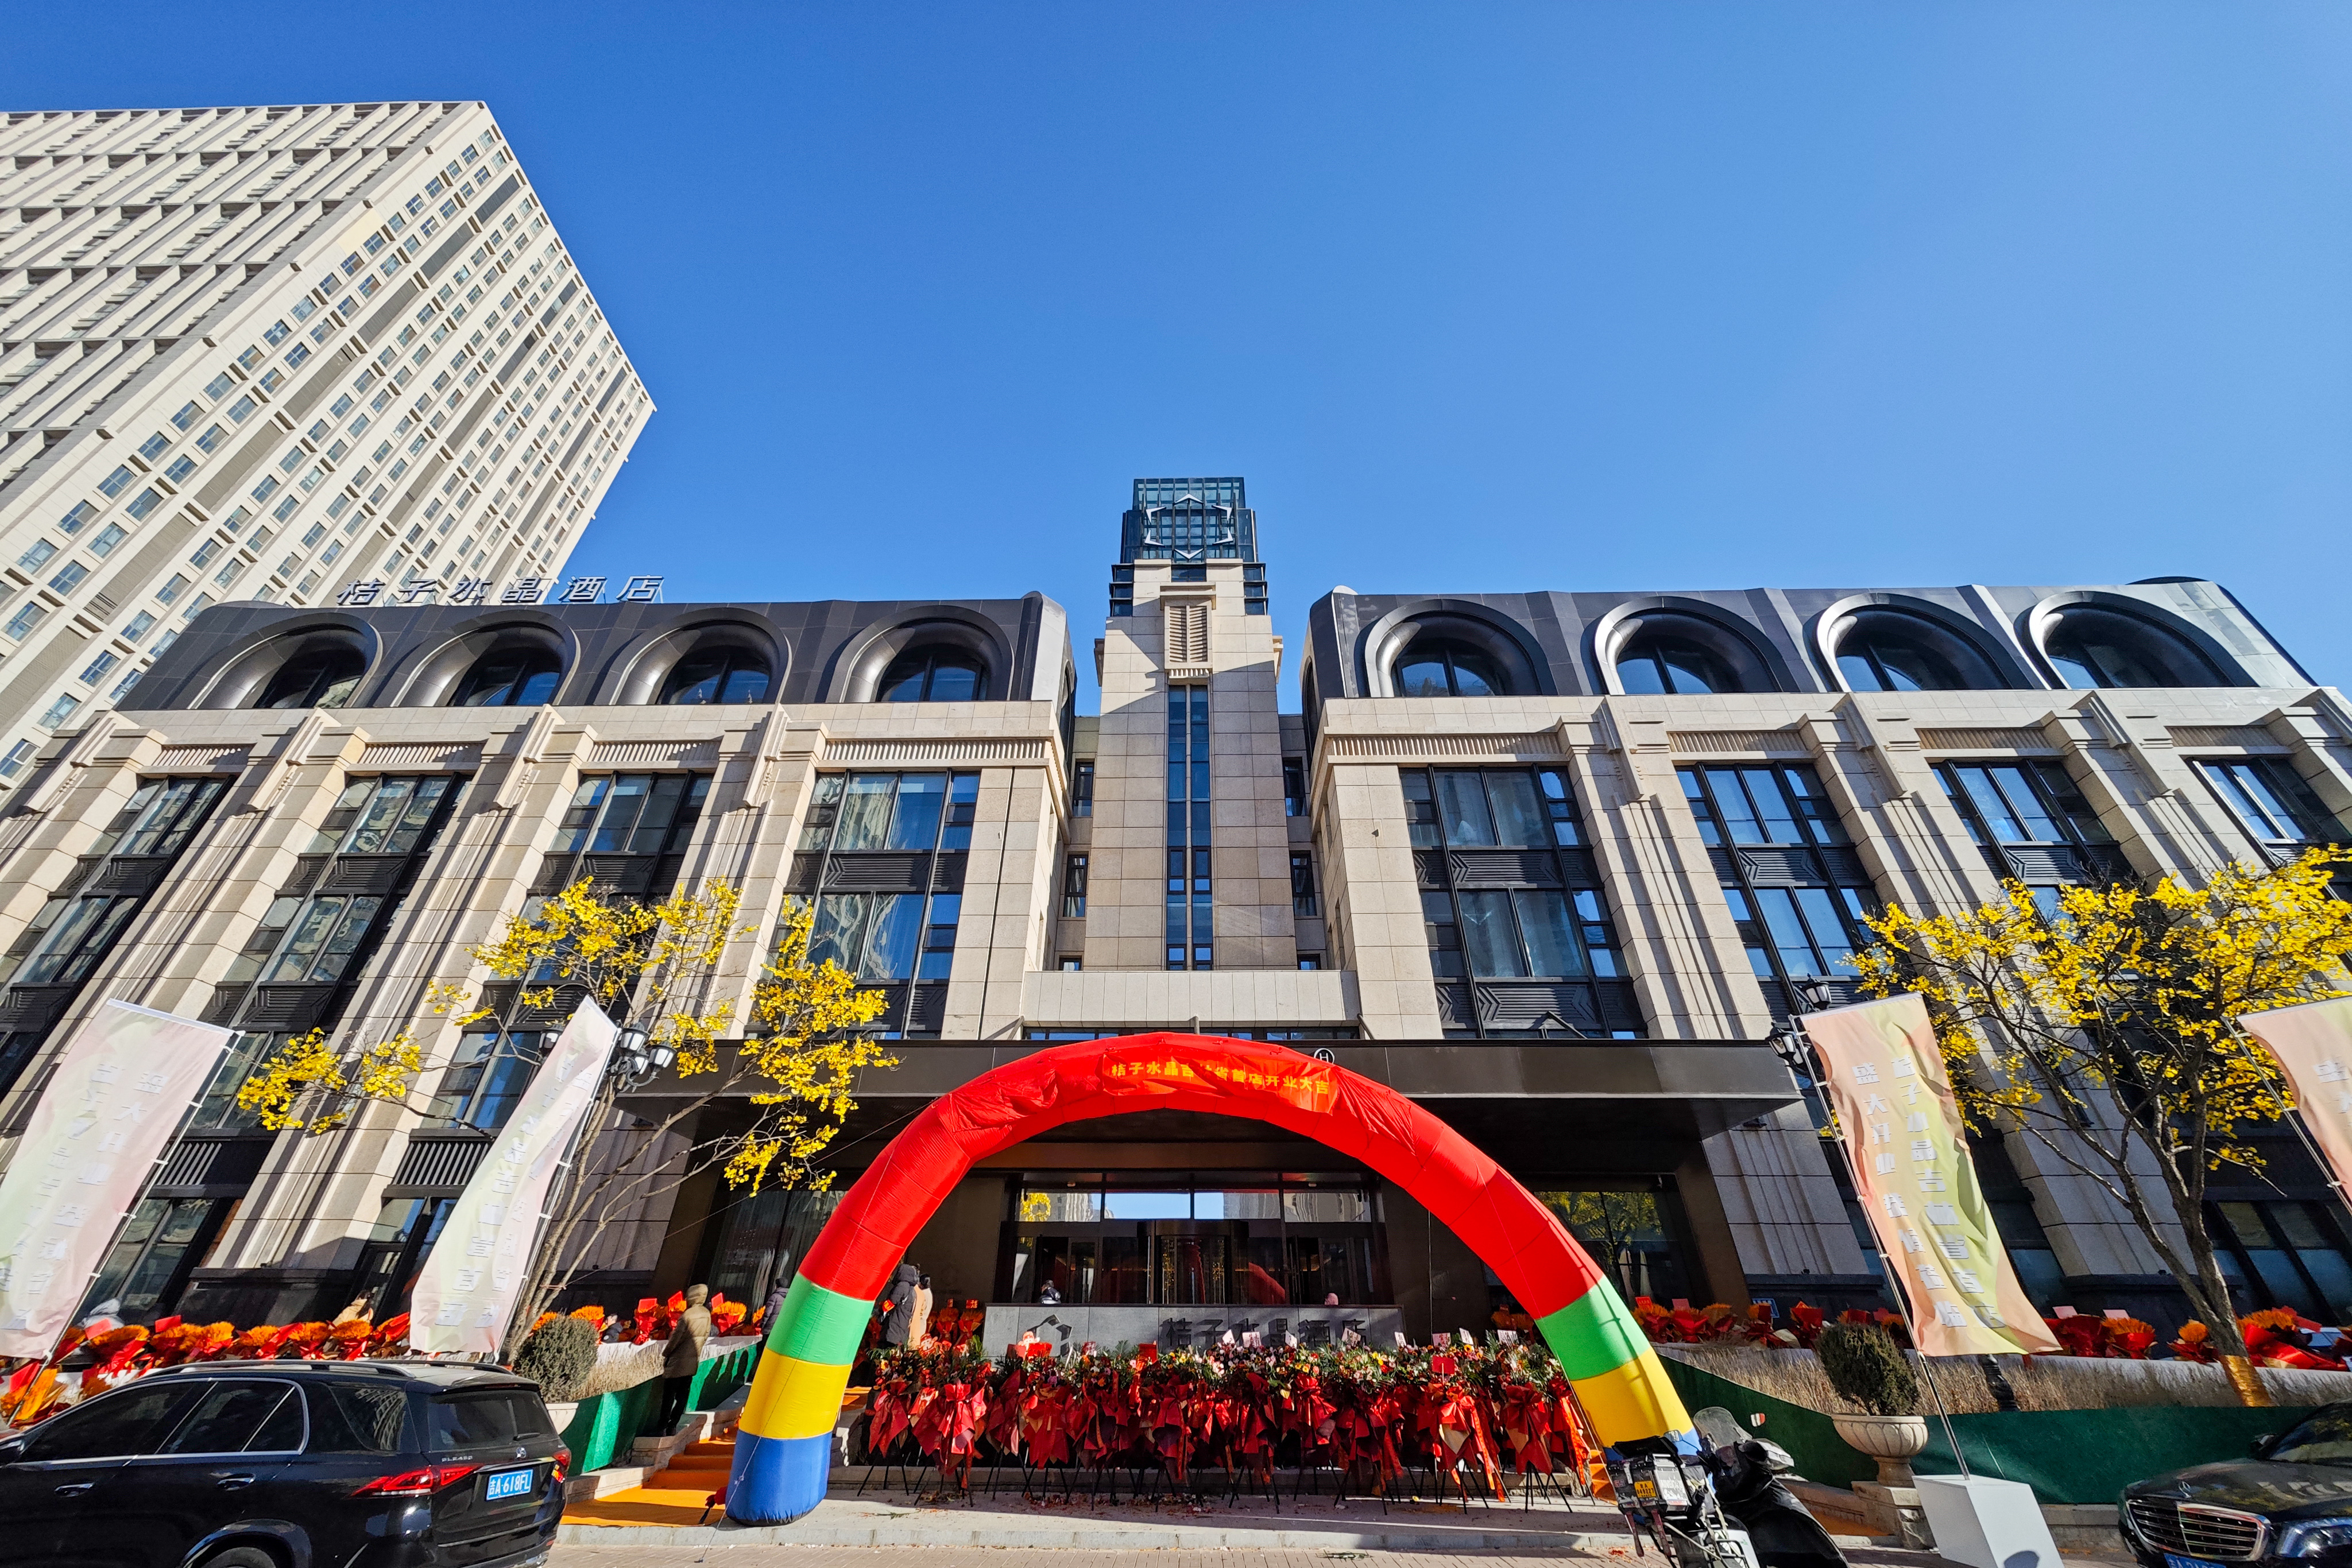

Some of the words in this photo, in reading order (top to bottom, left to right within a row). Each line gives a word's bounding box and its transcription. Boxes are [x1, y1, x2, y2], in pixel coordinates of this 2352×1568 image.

[336, 575, 664, 605] 桔子水晶酒店
[1112, 1062, 1329, 1095] 桔子水晶吉省首店开业大吉
